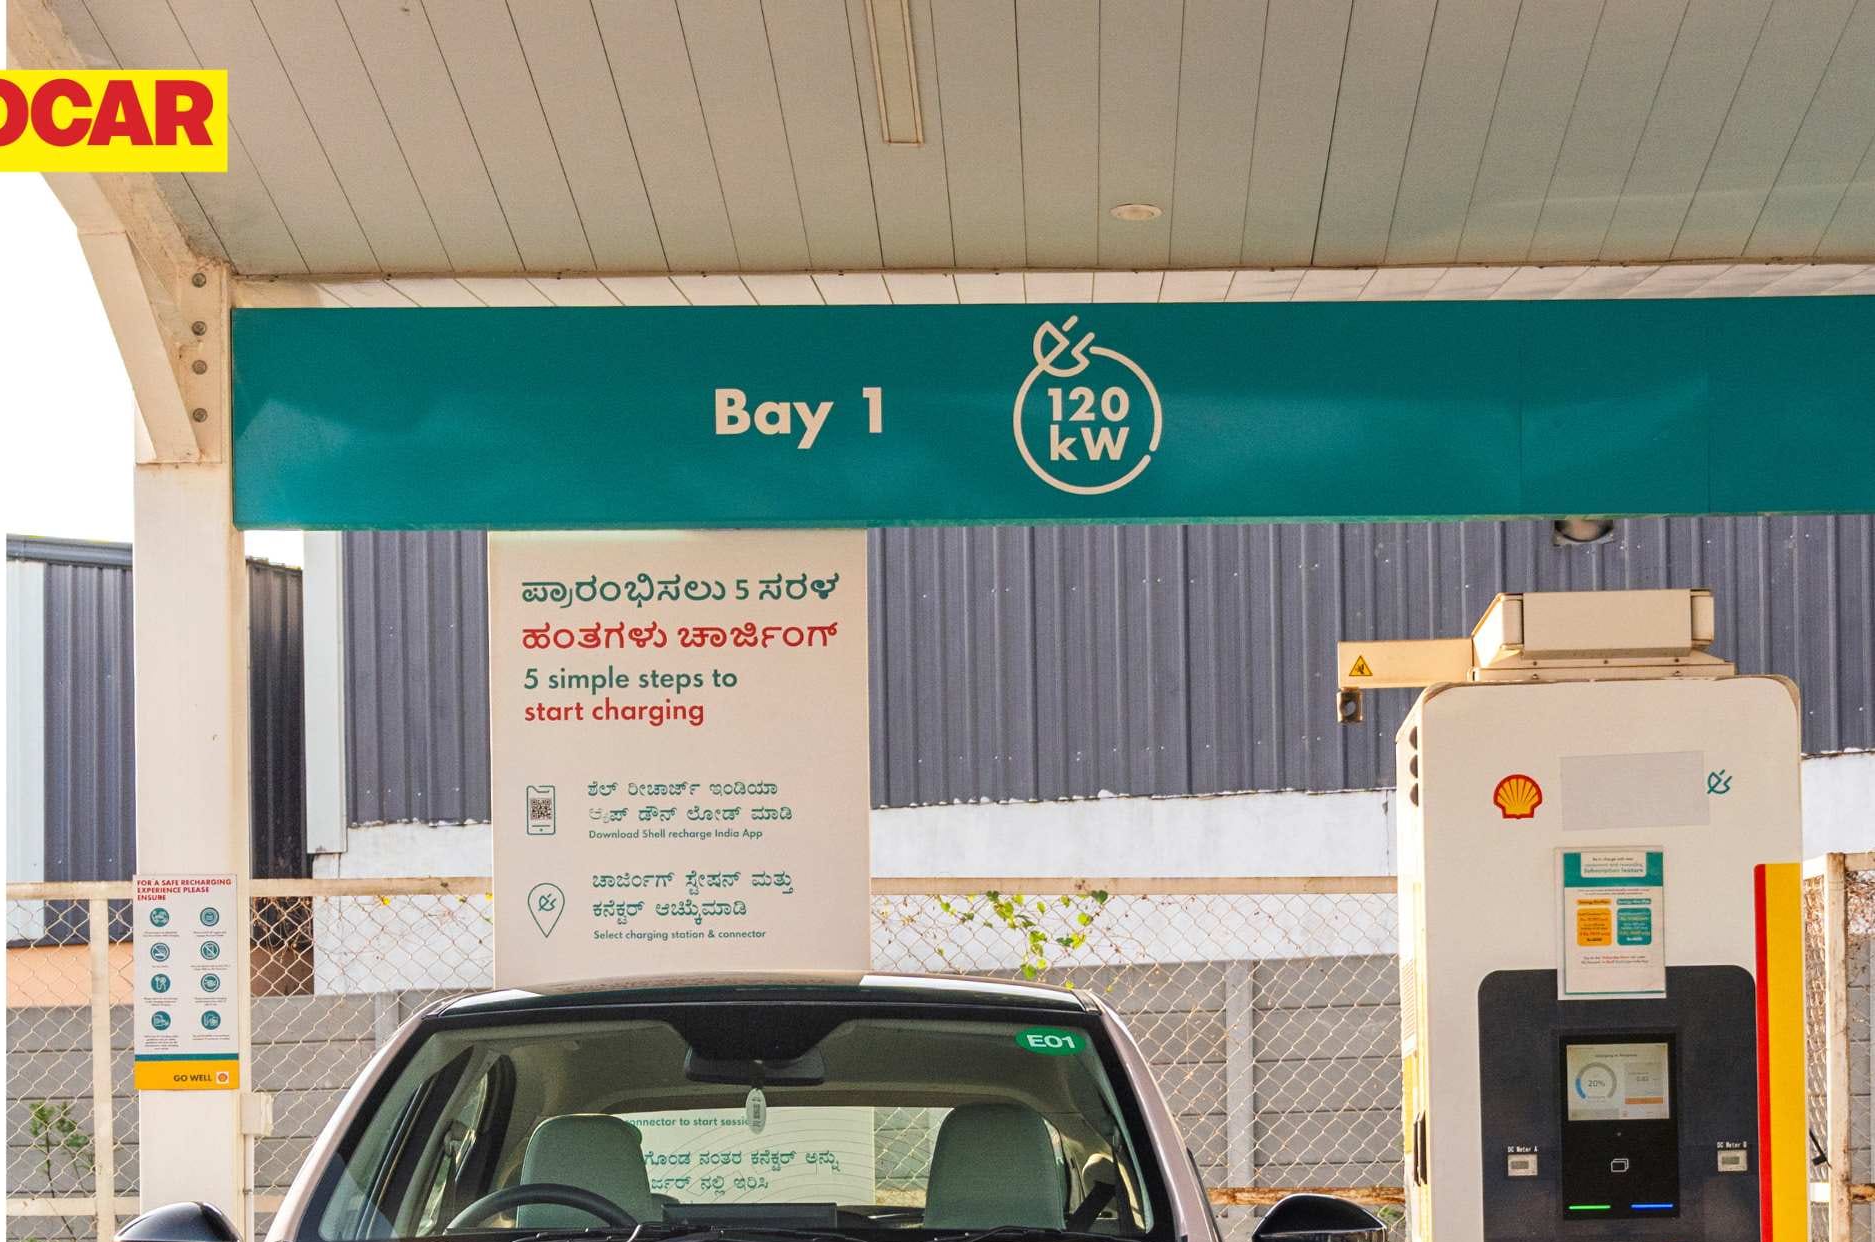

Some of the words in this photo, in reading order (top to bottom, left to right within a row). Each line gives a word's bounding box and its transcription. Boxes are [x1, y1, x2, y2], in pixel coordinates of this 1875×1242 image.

[714, 388, 835, 450] Bay
[862, 387, 883, 434] 1
[1047, 387, 1131, 422] 120
[1049, 424, 1131, 461] kW
[522, 573, 726, 608] ಪ್ರಾರಂಭಿಸಲು
[735, 579, 750, 600] 5
[759, 572, 840, 600] ಸರಳ
[522, 621, 668, 649] ಹಂತಗಳು
[524, 668, 539, 690] 5
[548, 665, 630, 695] simple
[638, 669, 704, 694] steps
[712, 669, 738, 688] to
[524, 702, 584, 721] start
[592, 697, 704, 727] charging
[589, 829, 639, 839] Download
[642, 829, 666, 838] Shell
[668, 829, 712, 840] recharge
[715, 828, 739, 838] India
[742, 828, 763, 840] App
[593, 930, 623, 940] Select
[625, 930, 668, 941] charging
[671, 930, 705, 940] station
[707, 929, 715, 938] &
[718, 930, 766, 939] connector
[173, 1074, 187, 1083] GO
[189, 1074, 212, 1082] WELL
[625, 1118, 676, 1127] onnector
[679, 1117, 691, 1127] to
[692, 1117, 718, 1127] start
